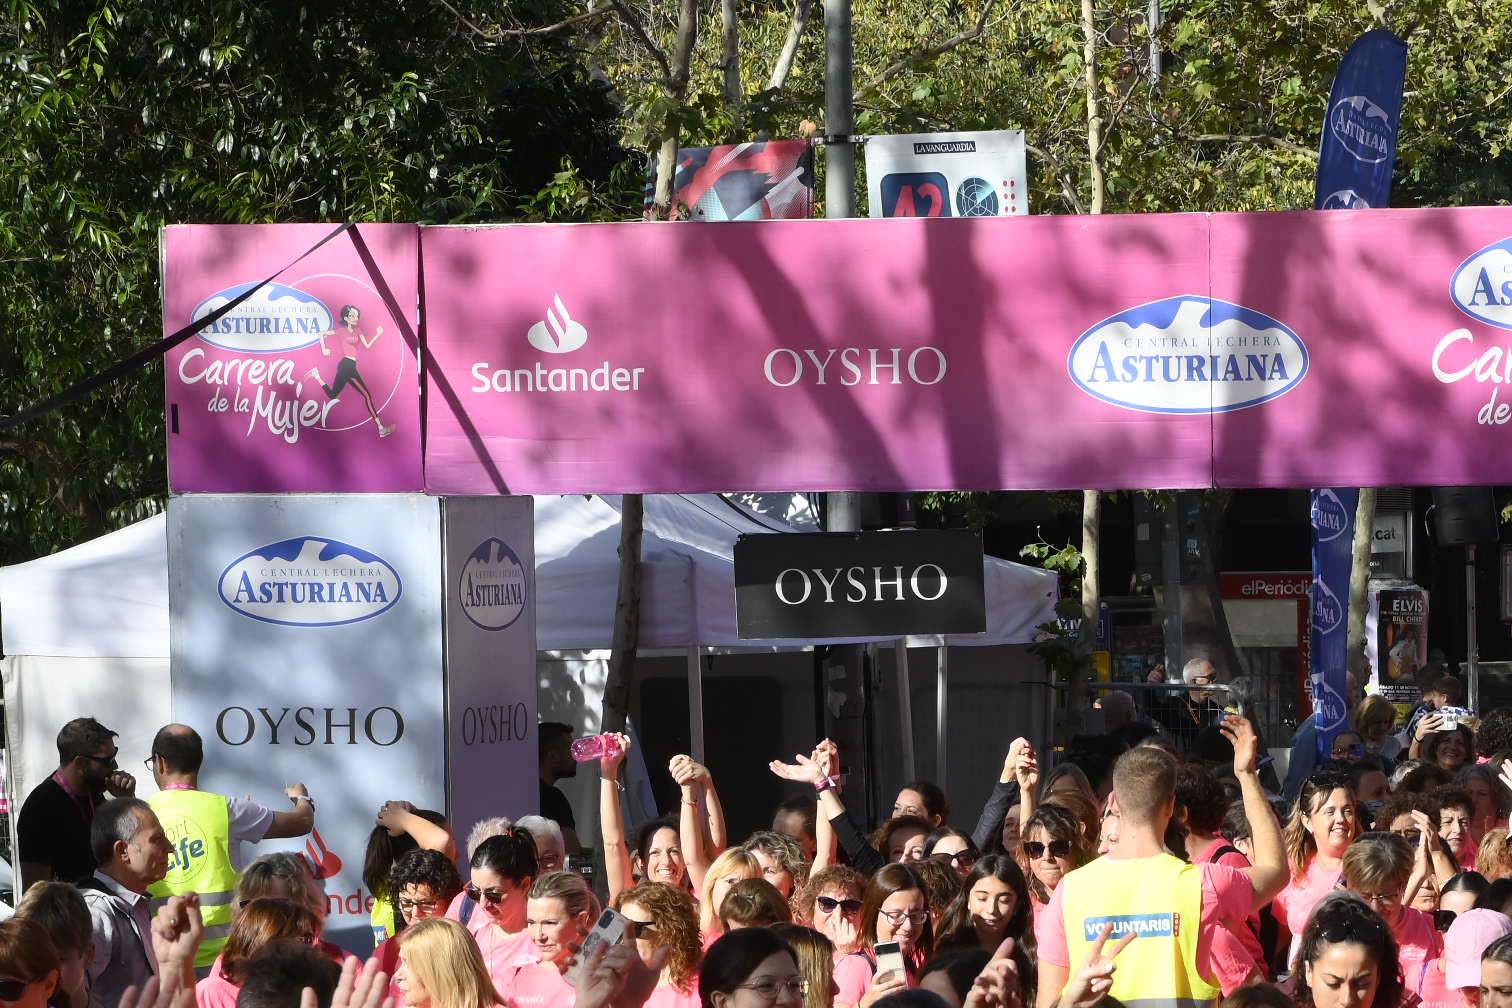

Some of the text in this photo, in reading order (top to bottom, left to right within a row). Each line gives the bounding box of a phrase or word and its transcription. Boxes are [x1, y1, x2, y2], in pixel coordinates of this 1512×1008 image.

[1124, 336, 1281, 349] CENTRAL LECHERA
[178, 348, 296, 385] Carrera
[472, 362, 645, 394] Santander
[763, 346, 949, 387] OYSHO
[1087, 340, 1289, 383] ASTURIANA
[207, 381, 342, 444] de la Mujer
[1477, 387, 1512, 425] de
[233, 570, 388, 603] ASTURIANA
[261, 568, 382, 578] CENTRAL LECHERA
[465, 574, 523, 607] ASTURIANA
[775, 562, 949, 608] OYSHO
[1242, 581, 1312, 597] elPeriódi
[1392, 599, 1424, 612] ELVIS
[216, 706, 405, 746] OYSHO
[462, 702, 528, 746] OYSHO
